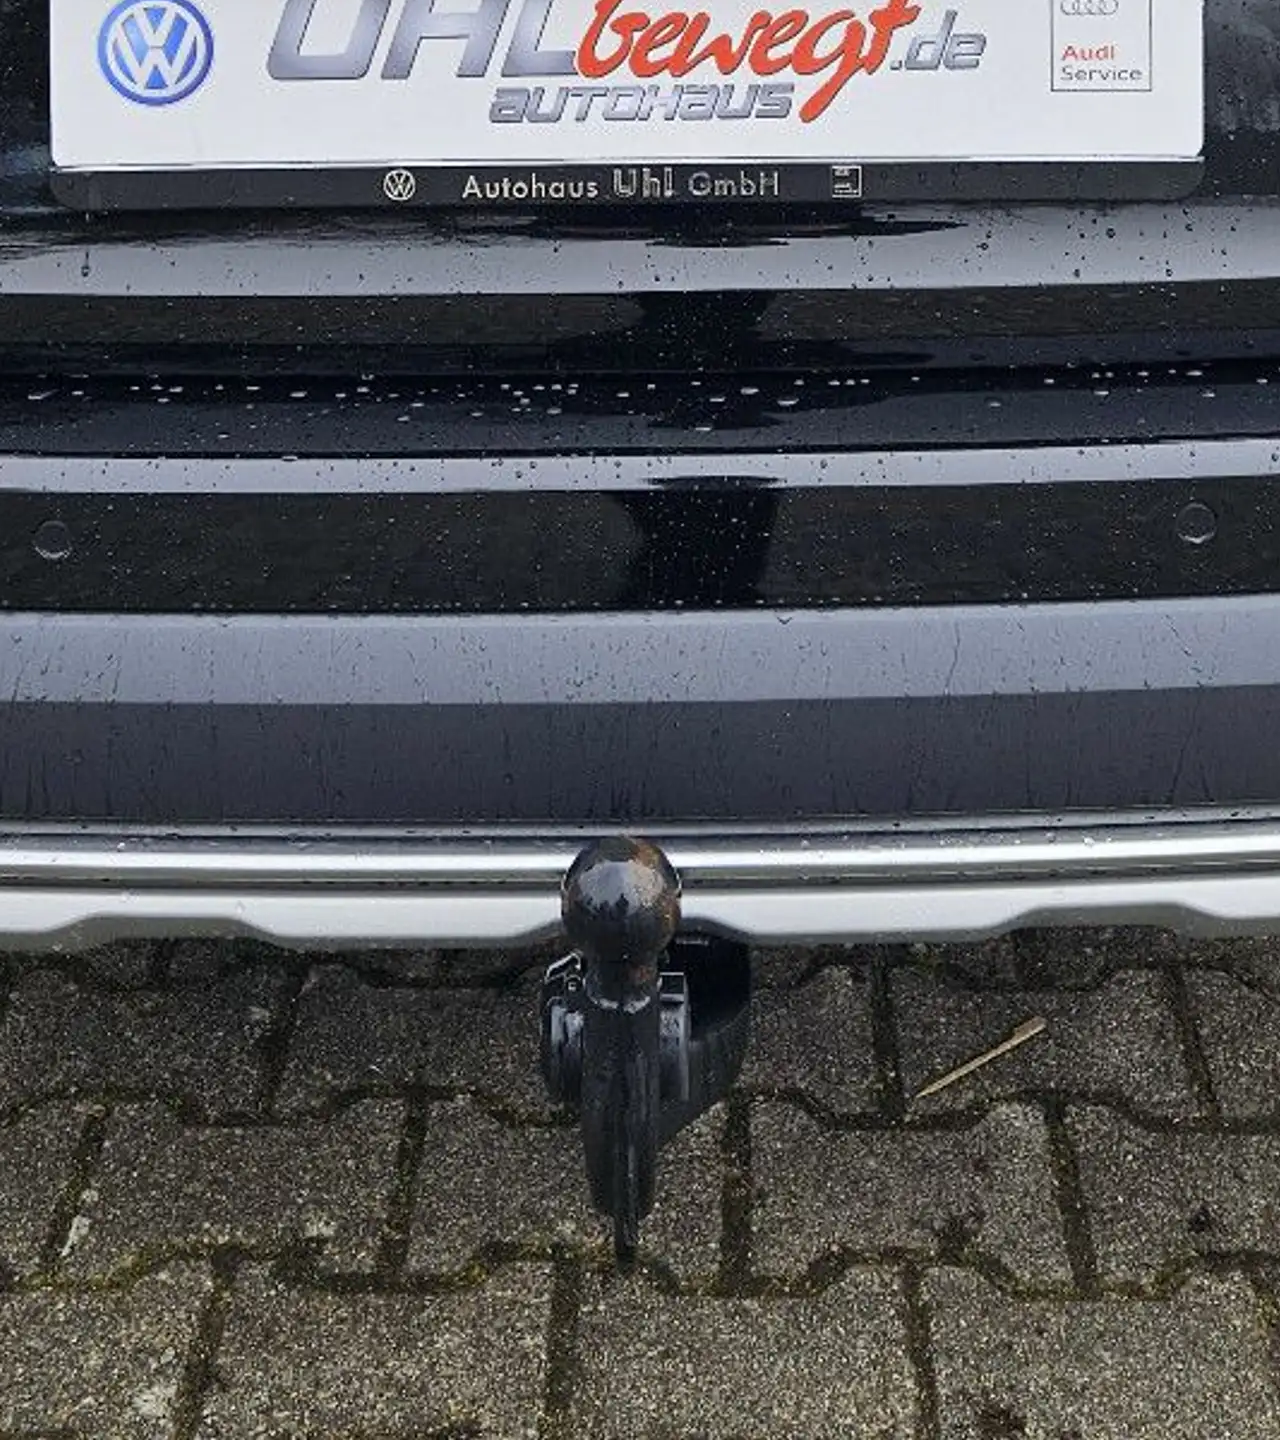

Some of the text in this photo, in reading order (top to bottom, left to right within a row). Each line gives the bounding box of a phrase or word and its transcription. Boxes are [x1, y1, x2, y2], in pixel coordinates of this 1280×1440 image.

[1061, 45, 1115, 61] Audi
[1060, 64, 1143, 81] Service
[462, 167, 780, 199] Autohaus Uhl GmbH
